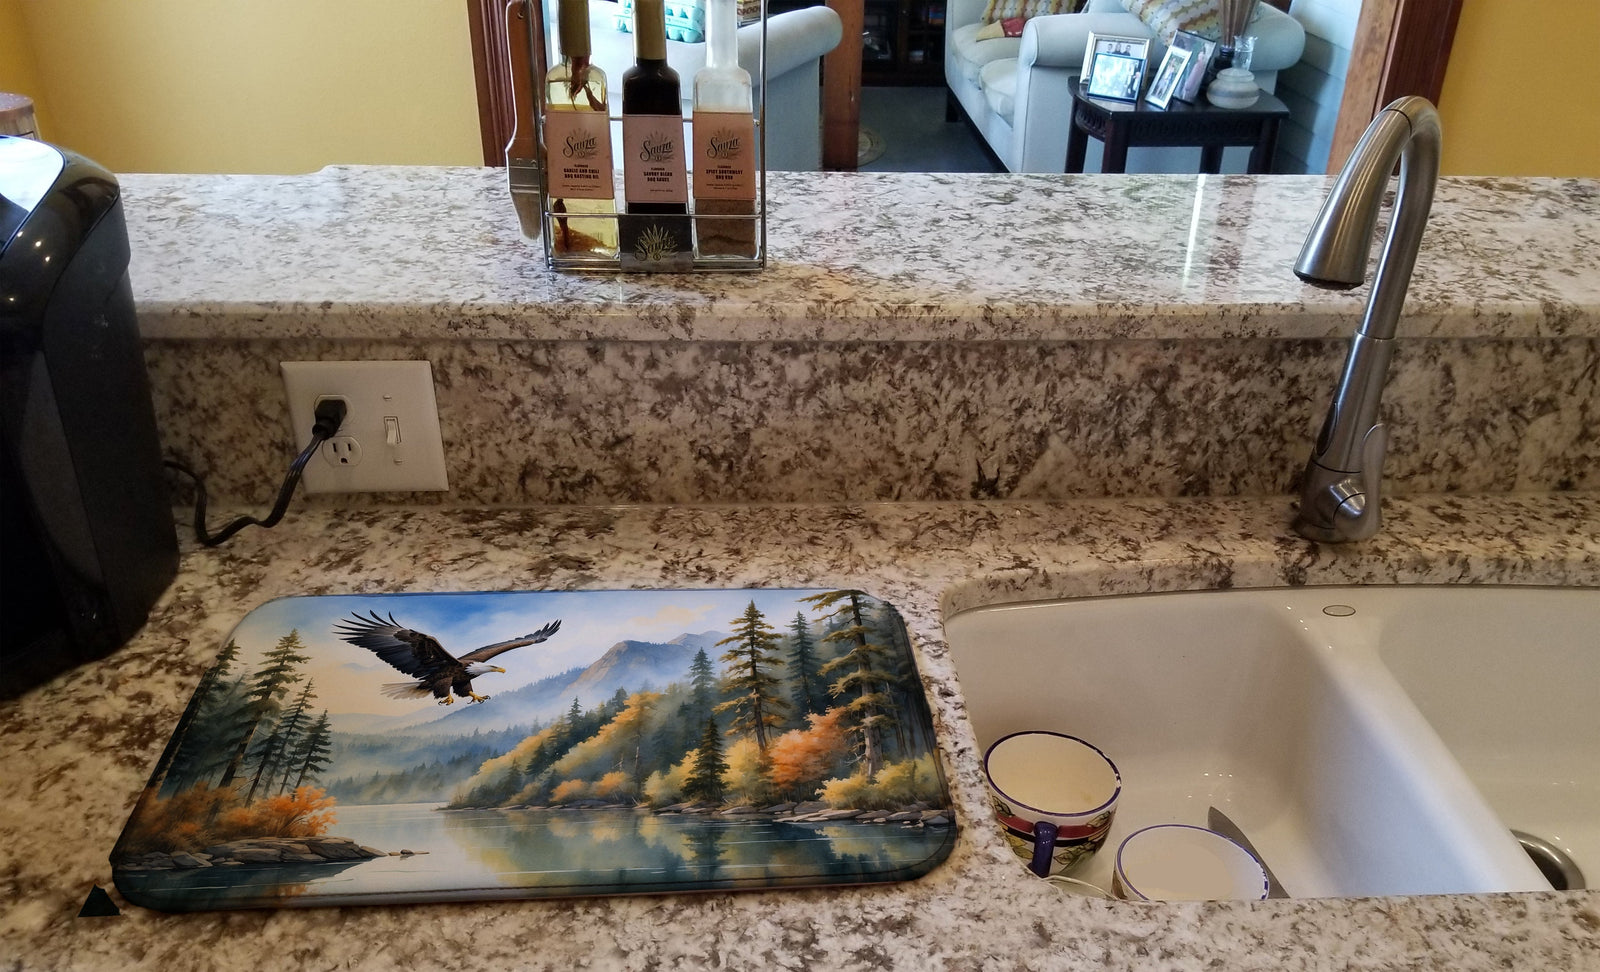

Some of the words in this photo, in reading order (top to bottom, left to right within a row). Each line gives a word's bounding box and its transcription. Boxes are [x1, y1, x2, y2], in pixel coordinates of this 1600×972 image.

[563, 136, 597, 158] Sauza
[640, 140, 673, 162] Sauza
[707, 137, 740, 159] Sauza
